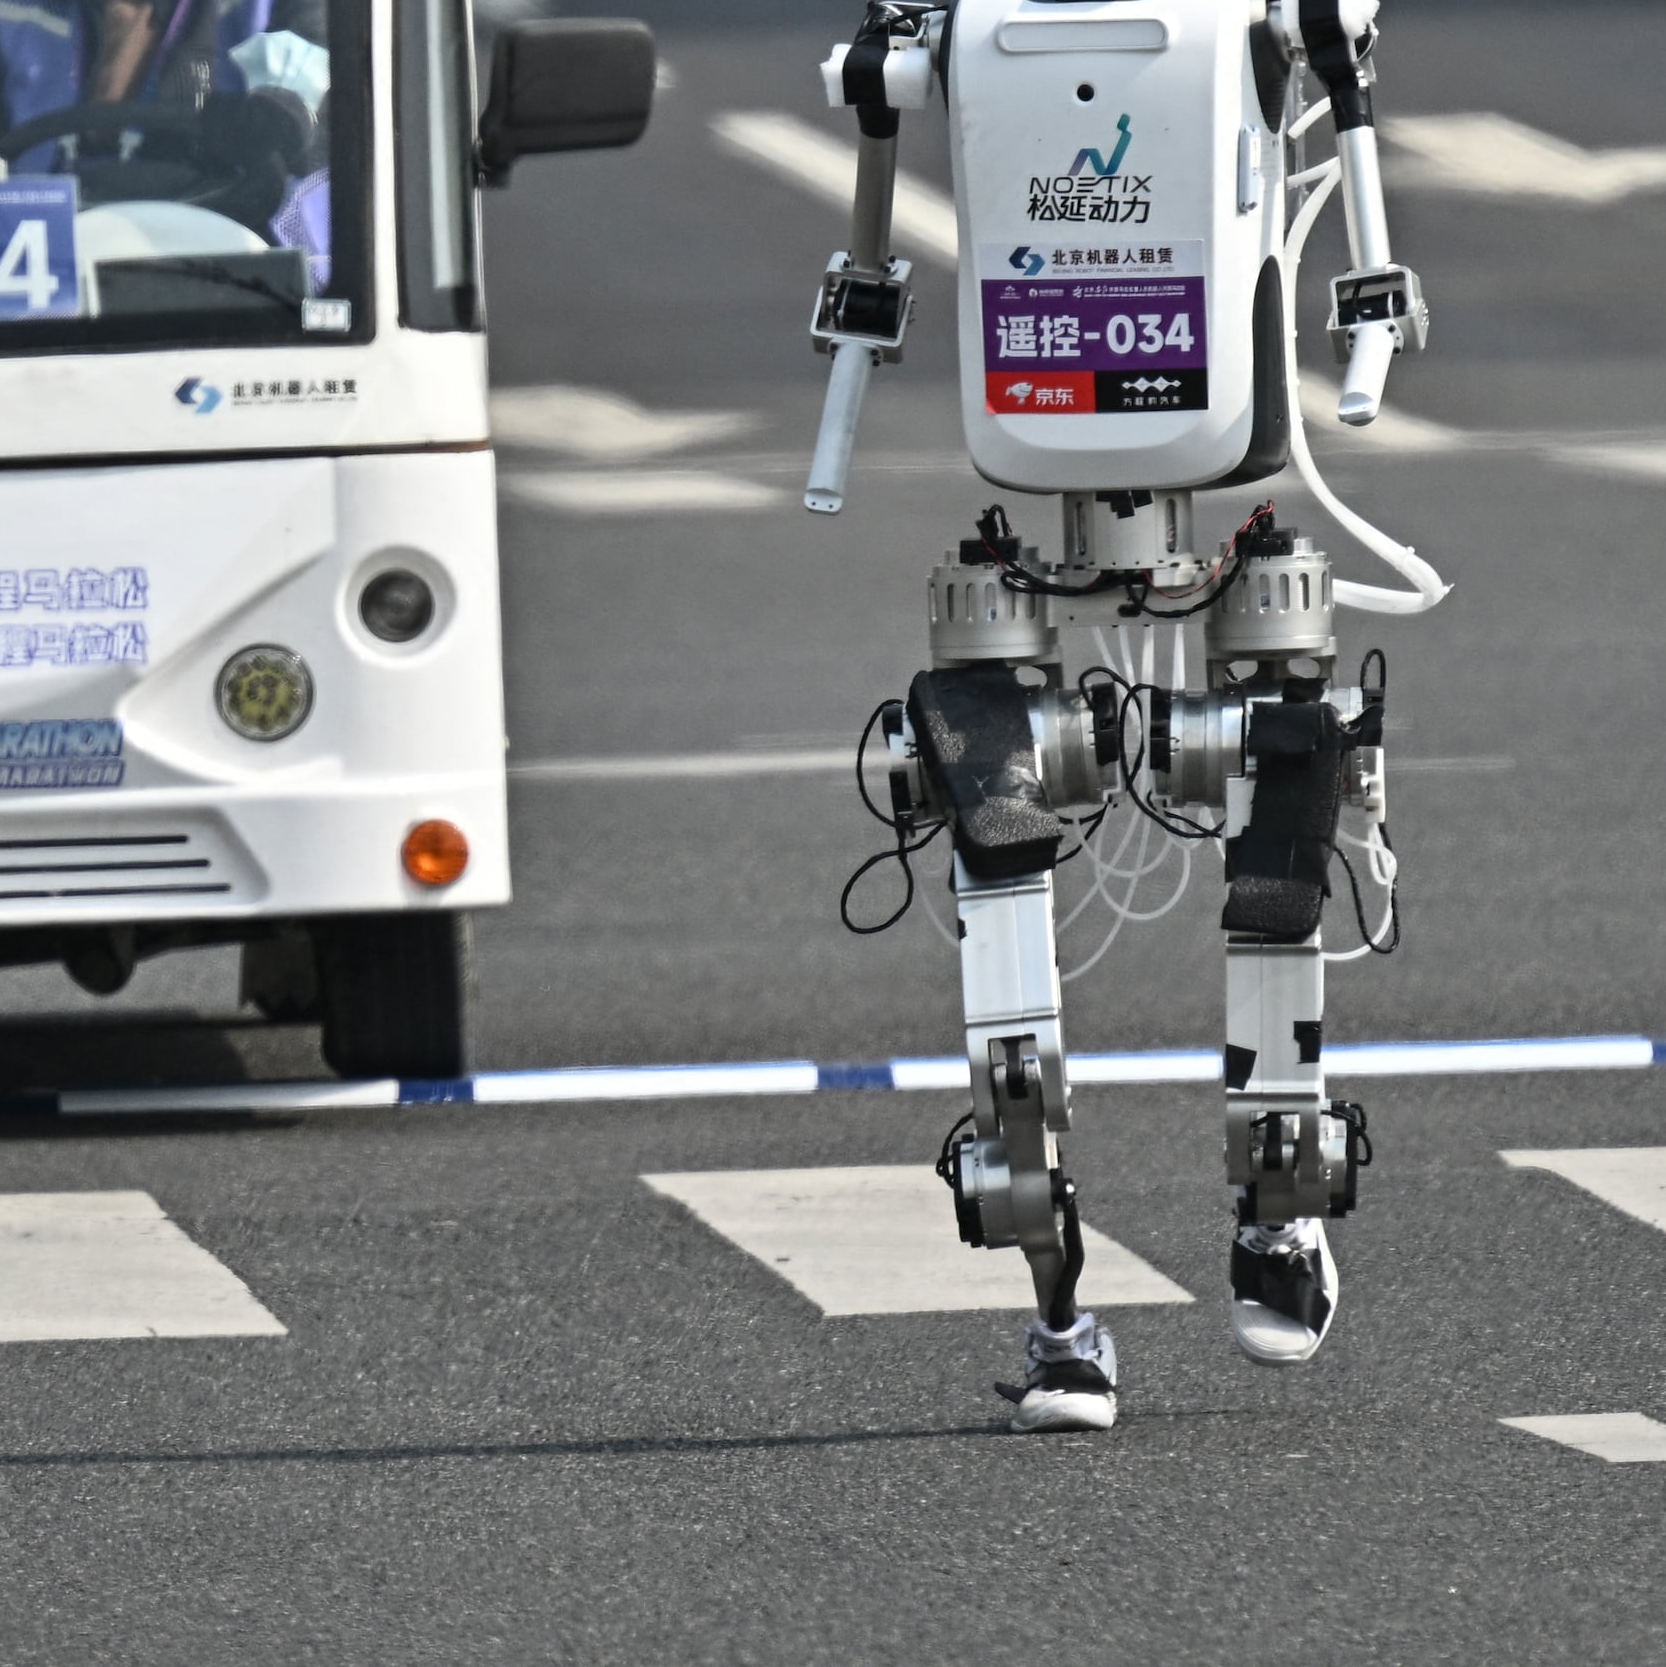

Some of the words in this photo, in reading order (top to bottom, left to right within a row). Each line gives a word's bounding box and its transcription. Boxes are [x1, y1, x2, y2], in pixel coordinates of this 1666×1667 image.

[1030, 175, 1153, 194] NOETIX
[1026, 194, 1151, 224] 松延动力
[1052, 247, 1174, 266] 北京机器人租赁
[996, 312, 1195, 358] 遥控-034
[1035, 388, 1075, 406] 京东
